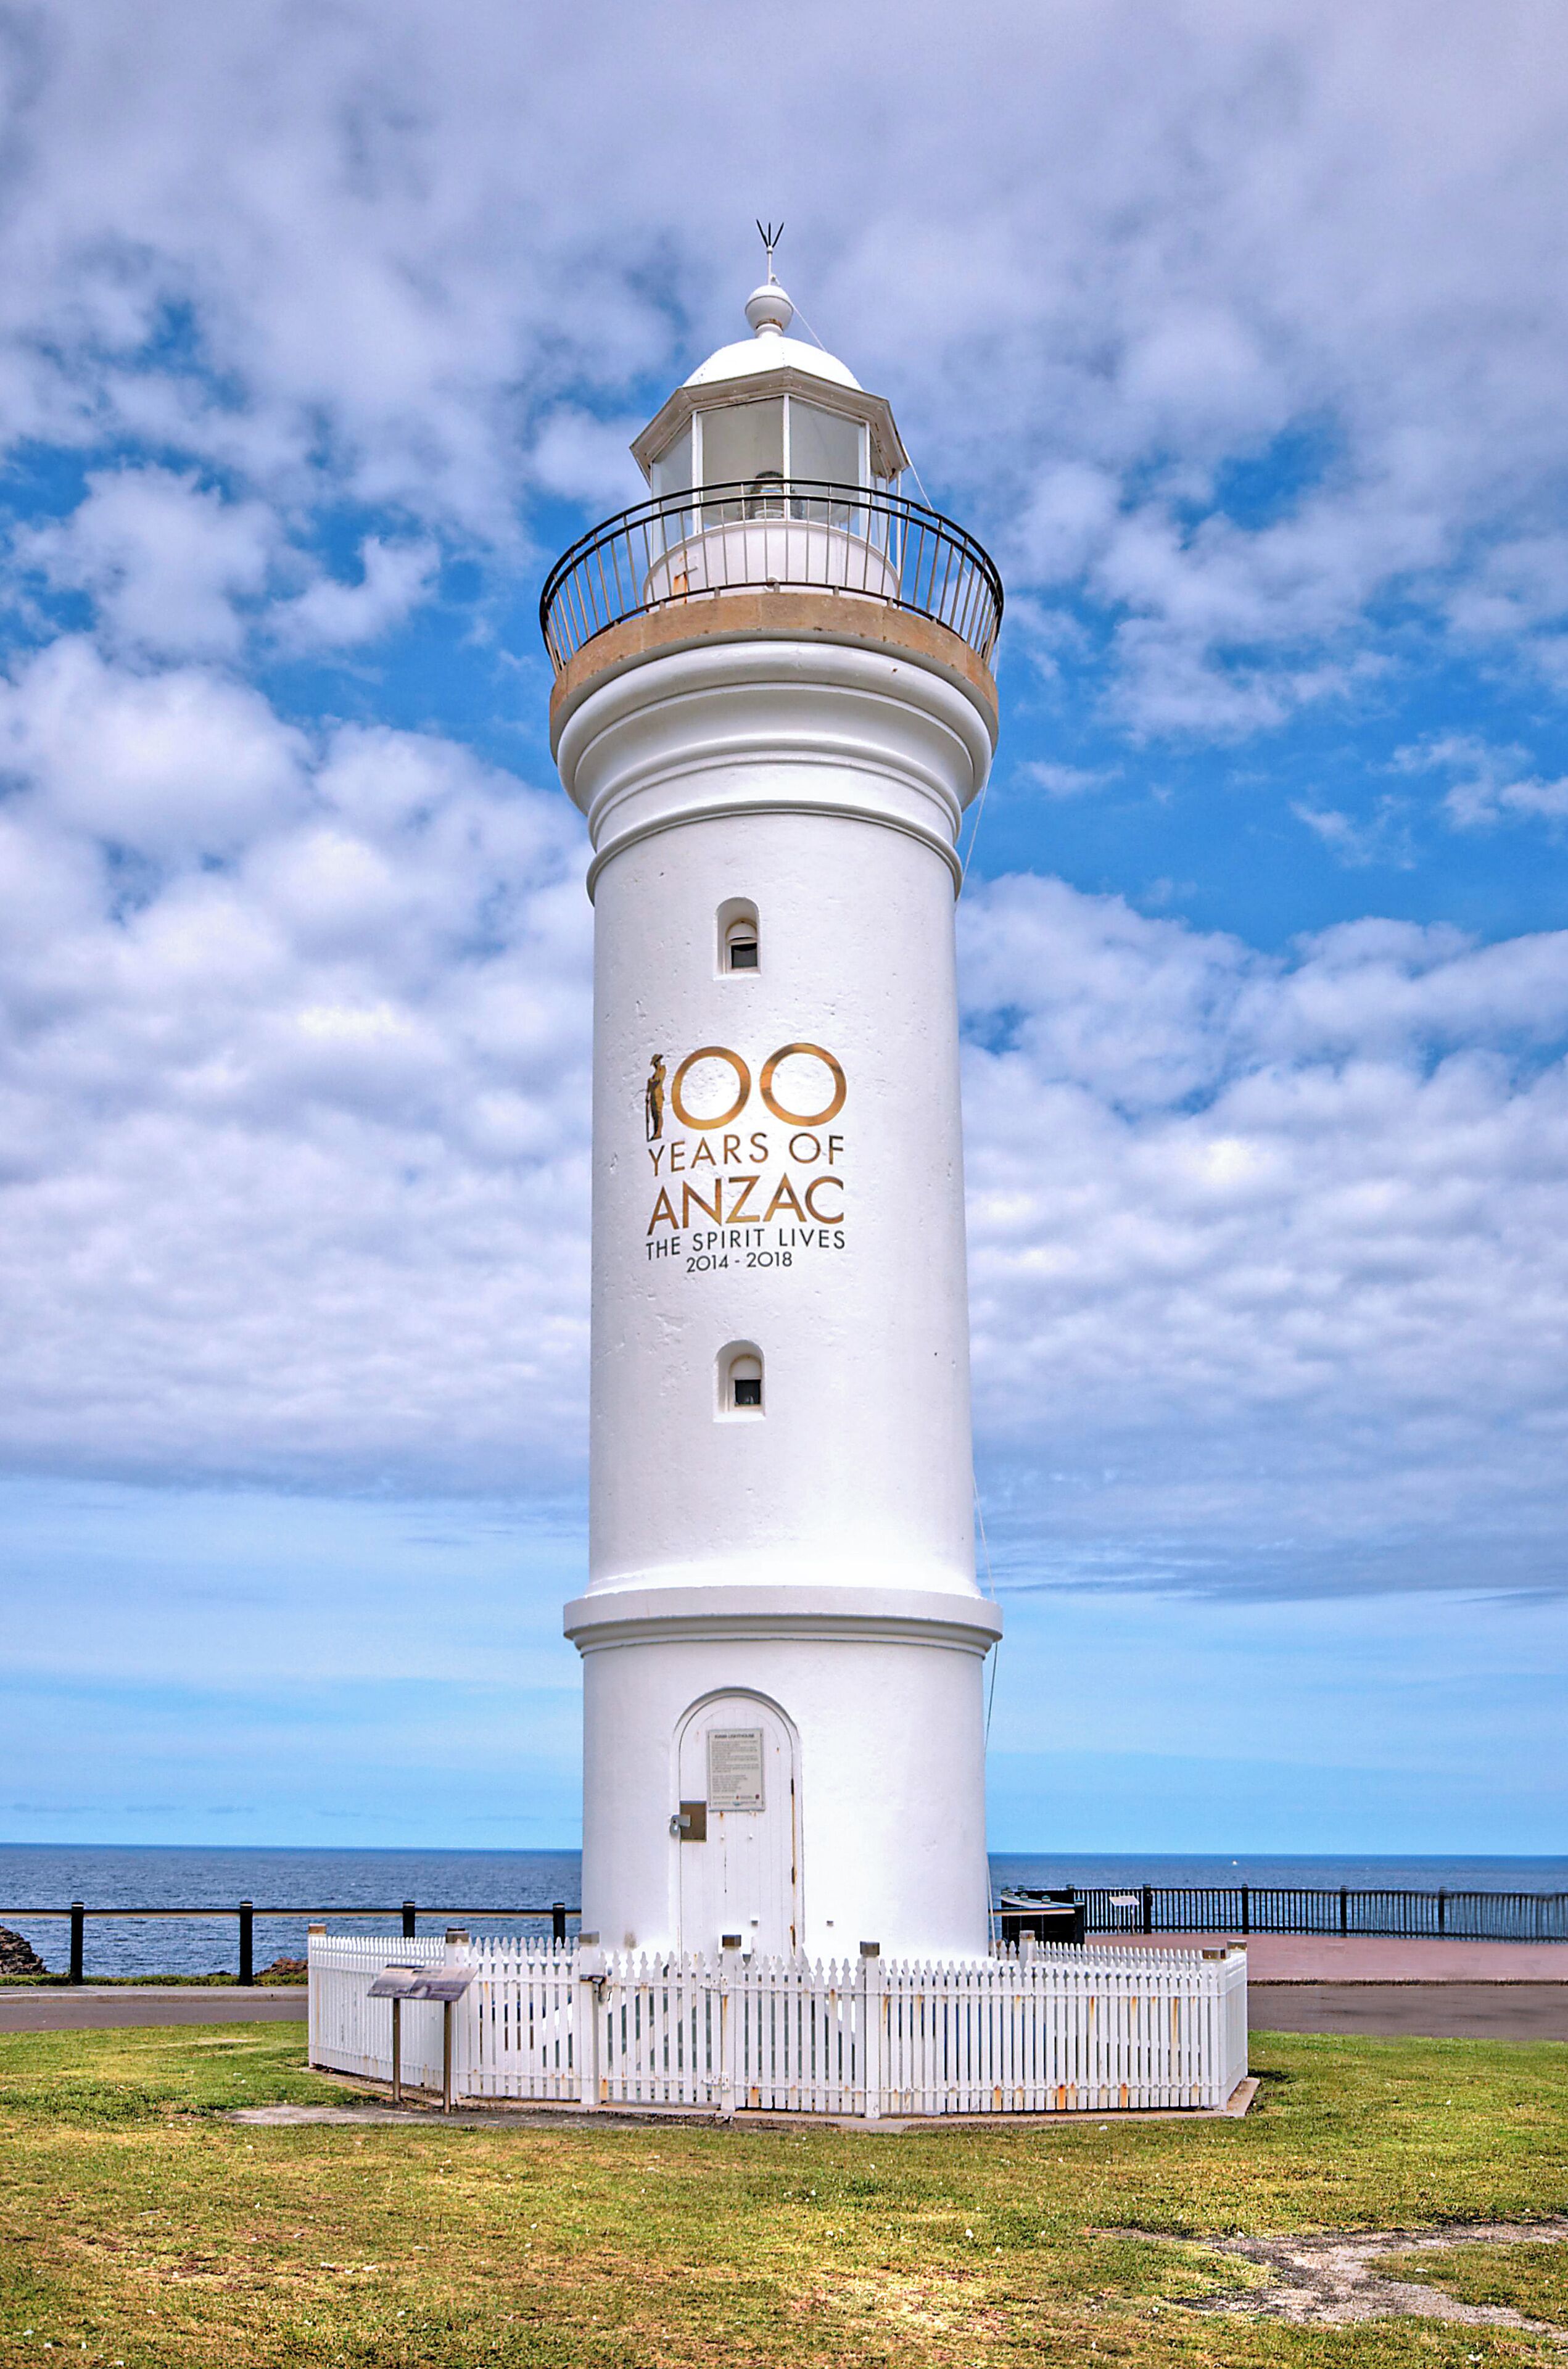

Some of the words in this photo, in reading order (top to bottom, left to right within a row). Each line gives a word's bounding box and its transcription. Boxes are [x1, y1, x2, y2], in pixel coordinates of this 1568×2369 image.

[648, 1133, 769, 1176] YEARS
[789, 1133, 844, 1165] OF
[646, 1173, 844, 1236] ANZAC
[646, 1236, 681, 1260] THE
[693, 1229, 764, 1251] SPIRIT
[780, 1228, 845, 1249] LIVES
[686, 1254, 729, 1273] 2014
[746, 1251, 793, 1268] 2018
